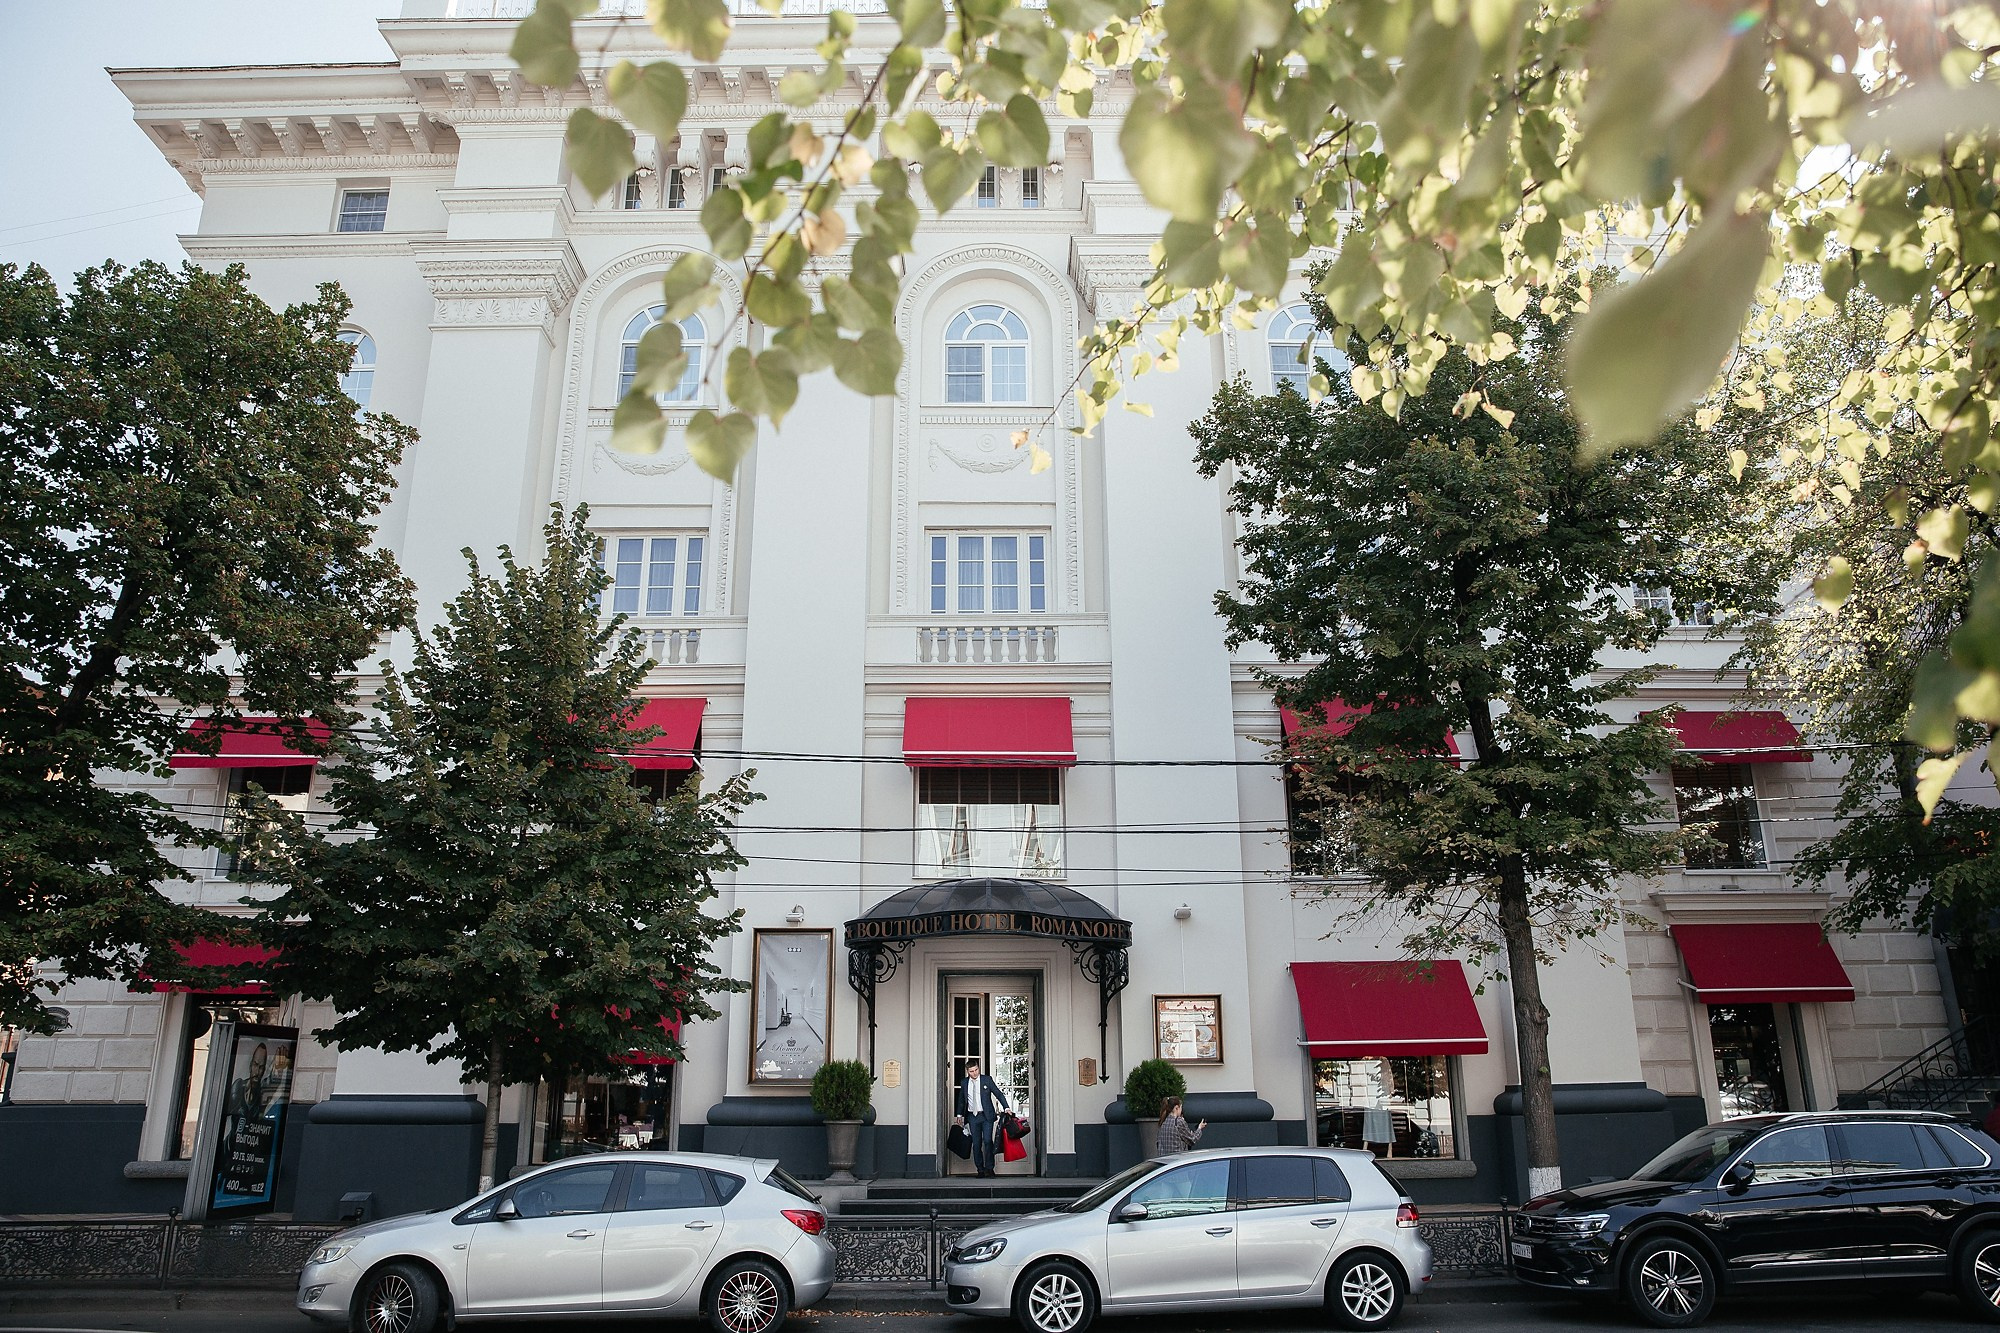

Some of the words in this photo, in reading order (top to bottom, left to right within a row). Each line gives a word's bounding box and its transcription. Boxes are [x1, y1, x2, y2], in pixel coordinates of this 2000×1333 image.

[856, 915, 943, 938] BOUTIQUE
[950, 913, 1023, 931] HOTEL
[1031, 915, 1125, 939] ROMANOFF
[249, 1123, 271, 1135] ЗНАЧИТ
[236, 1134, 259, 1147] ВЫГОДА
[232, 1152, 239, 1160] 30
[246, 1153, 255, 1162] 500
[226, 1180, 240, 1190] 400
